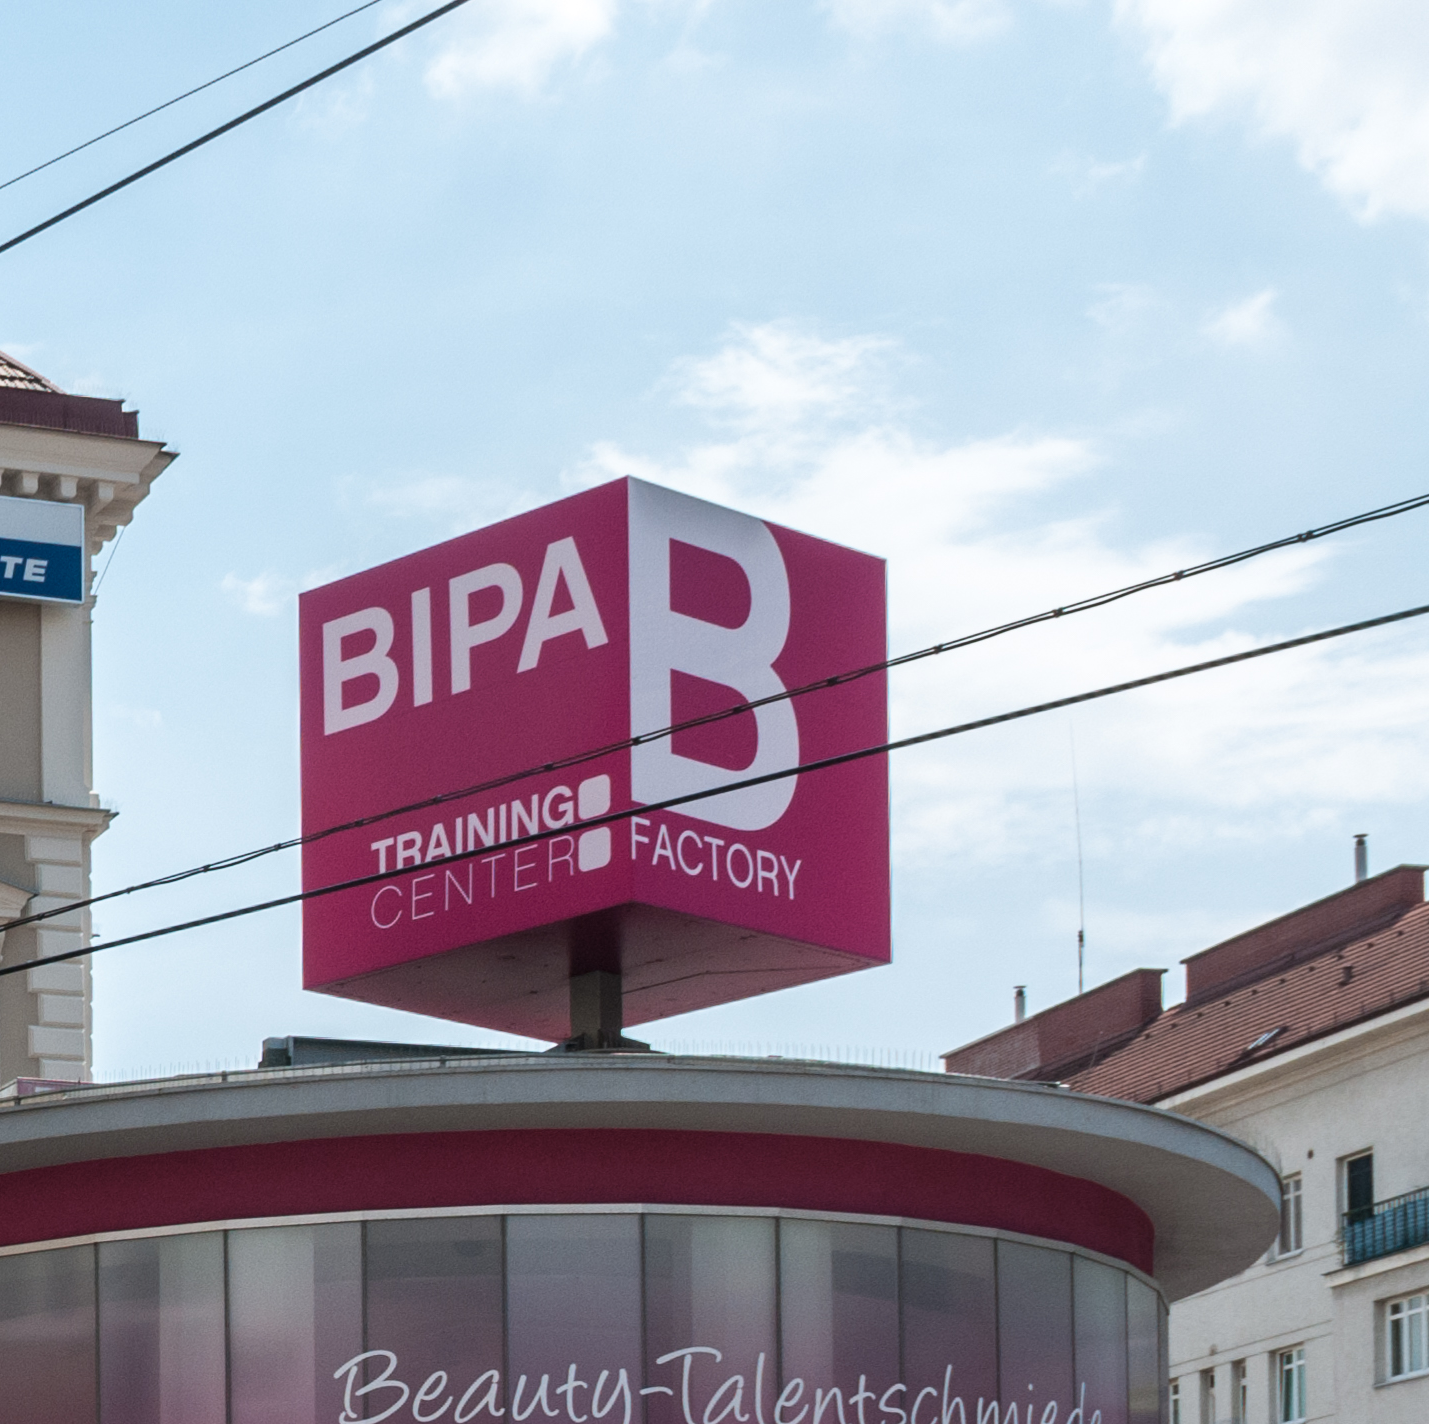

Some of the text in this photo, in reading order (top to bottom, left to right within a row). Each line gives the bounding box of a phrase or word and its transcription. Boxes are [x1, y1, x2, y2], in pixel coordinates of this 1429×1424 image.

[322, 536, 609, 736] BIPA
[371, 784, 575, 874] TRAINING
[629, 816, 802, 900] FACTORY
[370, 834, 575, 930] CENTER
